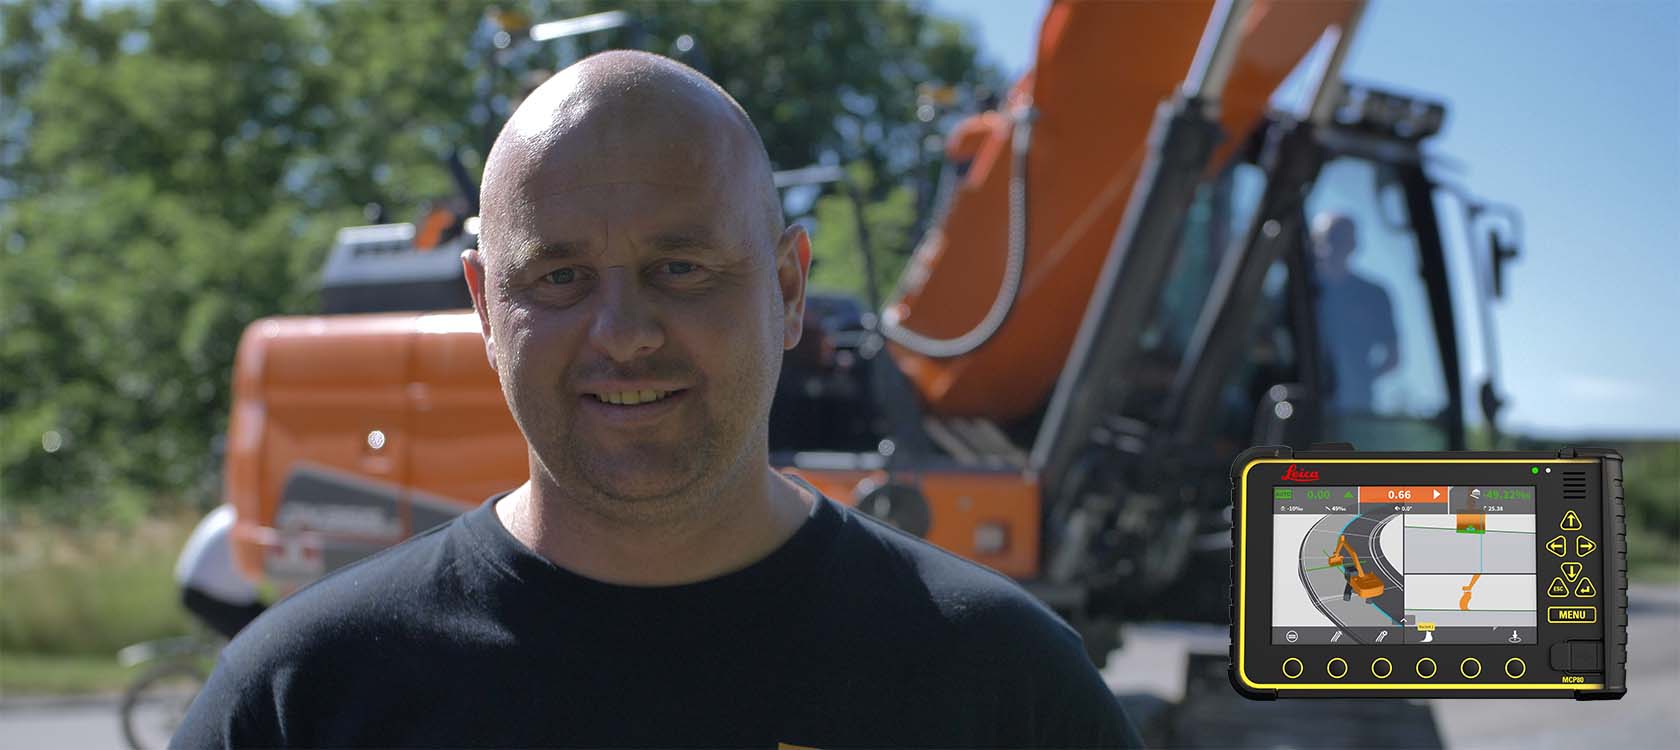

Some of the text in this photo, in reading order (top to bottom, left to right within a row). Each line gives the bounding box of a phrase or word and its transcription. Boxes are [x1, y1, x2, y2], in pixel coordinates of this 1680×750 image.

[1281, 463, 1319, 482] Leica
[1306, 490, 1331, 499] 0.00
[1388, 490, 1412, 500] 0.66
[1559, 610, 1586, 619] MENU
